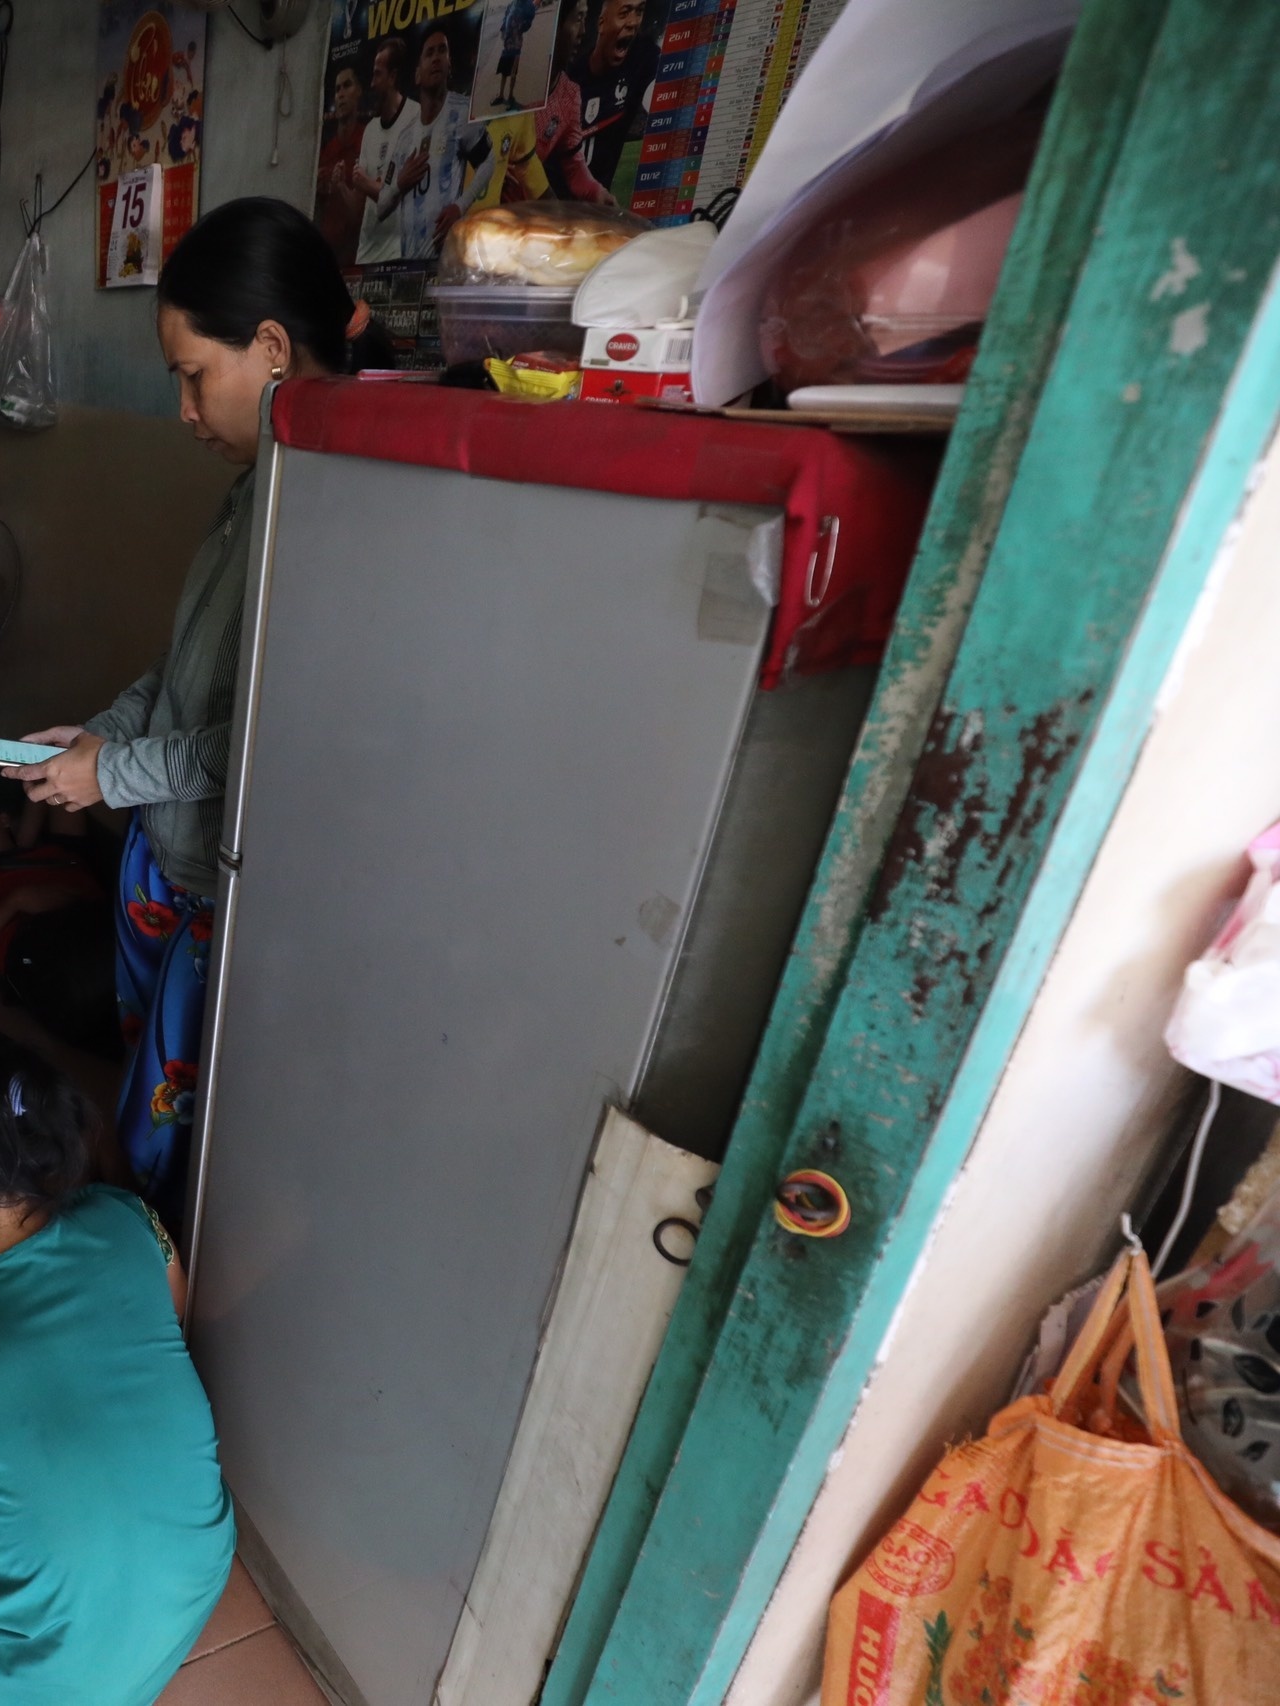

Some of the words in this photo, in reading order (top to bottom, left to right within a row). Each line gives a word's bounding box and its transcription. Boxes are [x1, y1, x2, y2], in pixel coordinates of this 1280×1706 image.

[675, 0, 697, 12] 25/11
[669, 30, 690, 42] 26/11
[662, 61, 684, 73] 27/11
[656, 90, 678, 102] 28/11
[651, 117, 672, 127] 29/11
[647, 142, 667, 152] 30/11
[640, 171, 661, 181] 01/12
[122, 182, 147, 229] 15
[633, 199, 656, 209] 02/12
[608, 342, 638, 351] CRAVEN
